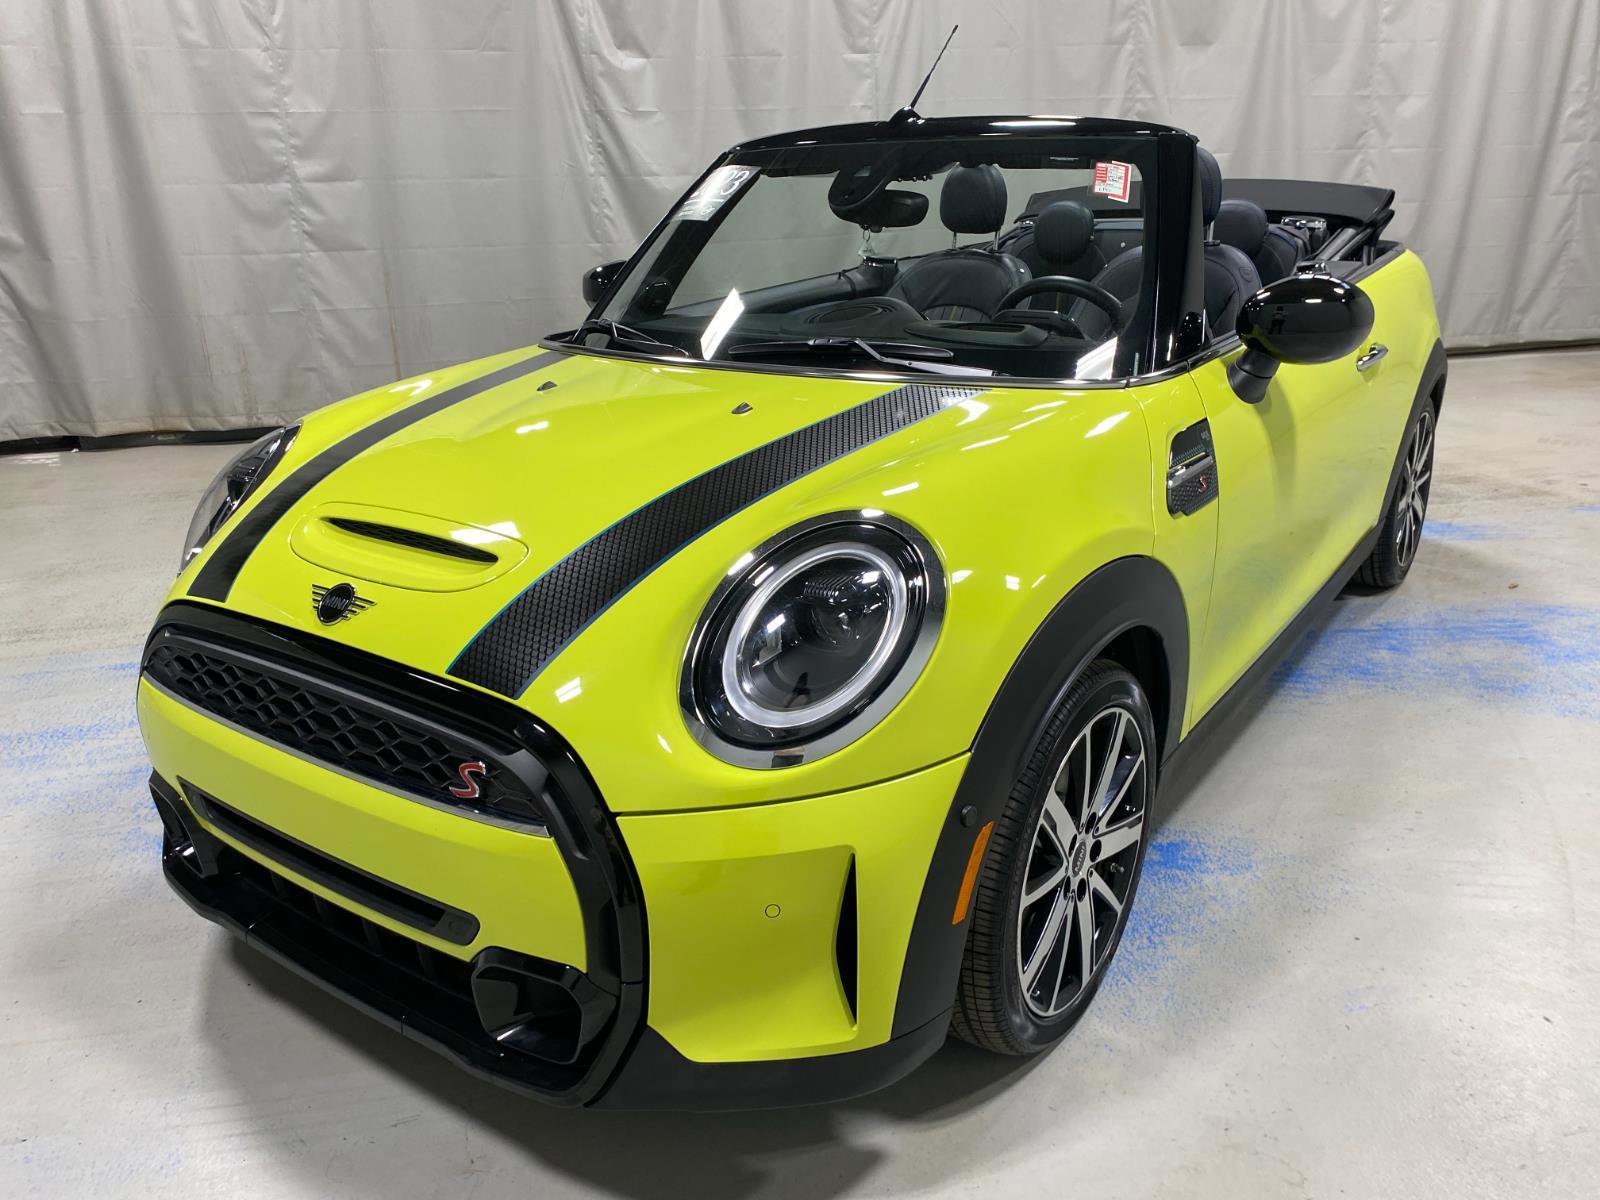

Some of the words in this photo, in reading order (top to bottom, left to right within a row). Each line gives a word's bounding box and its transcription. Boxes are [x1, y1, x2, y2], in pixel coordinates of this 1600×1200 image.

[1199, 474, 1209, 493] S
[322, 595, 349, 611] MINI
[448, 761, 486, 798] S
